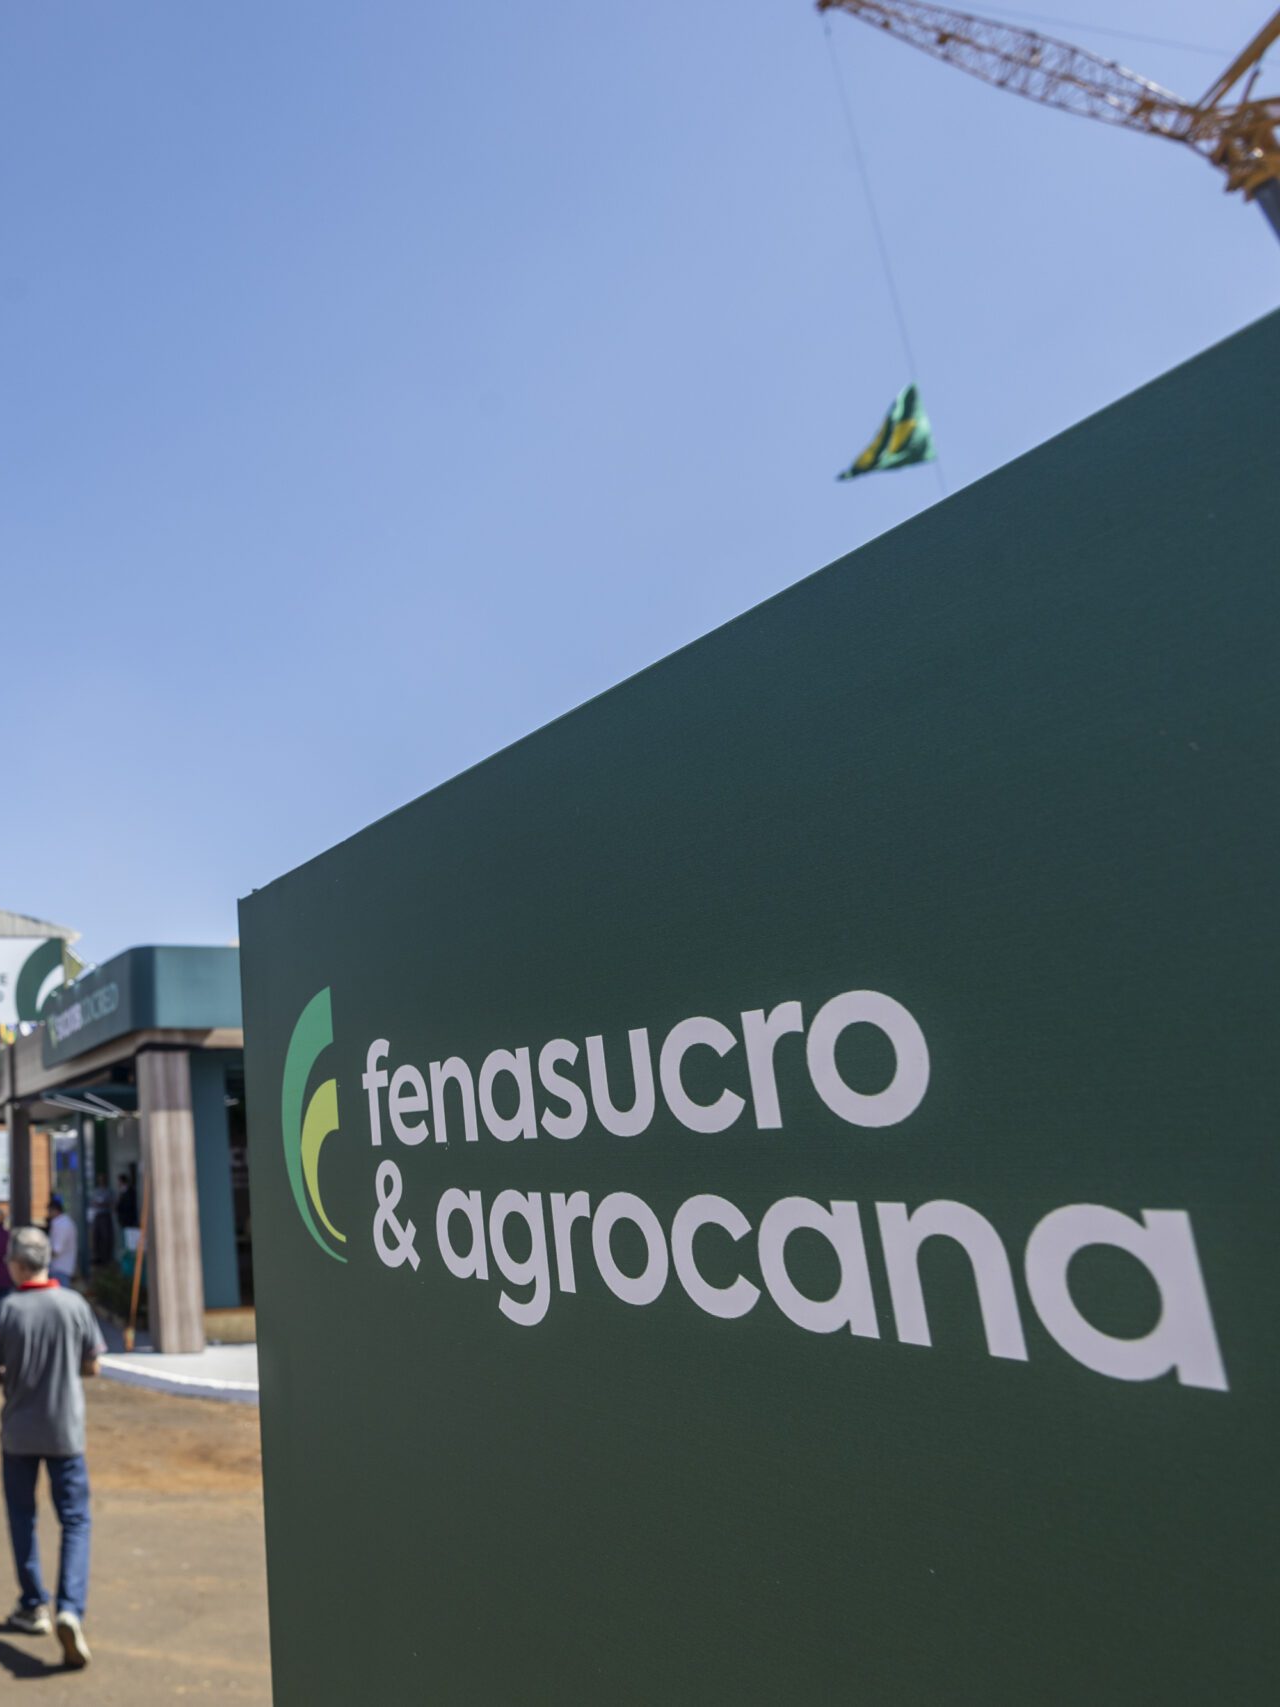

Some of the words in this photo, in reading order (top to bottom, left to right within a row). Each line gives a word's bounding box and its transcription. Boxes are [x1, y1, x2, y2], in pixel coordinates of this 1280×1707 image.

[362, 990, 930, 1146] fenasucro
[372, 1160, 421, 1271] &
[435, 1187, 1229, 1391] agrocana
